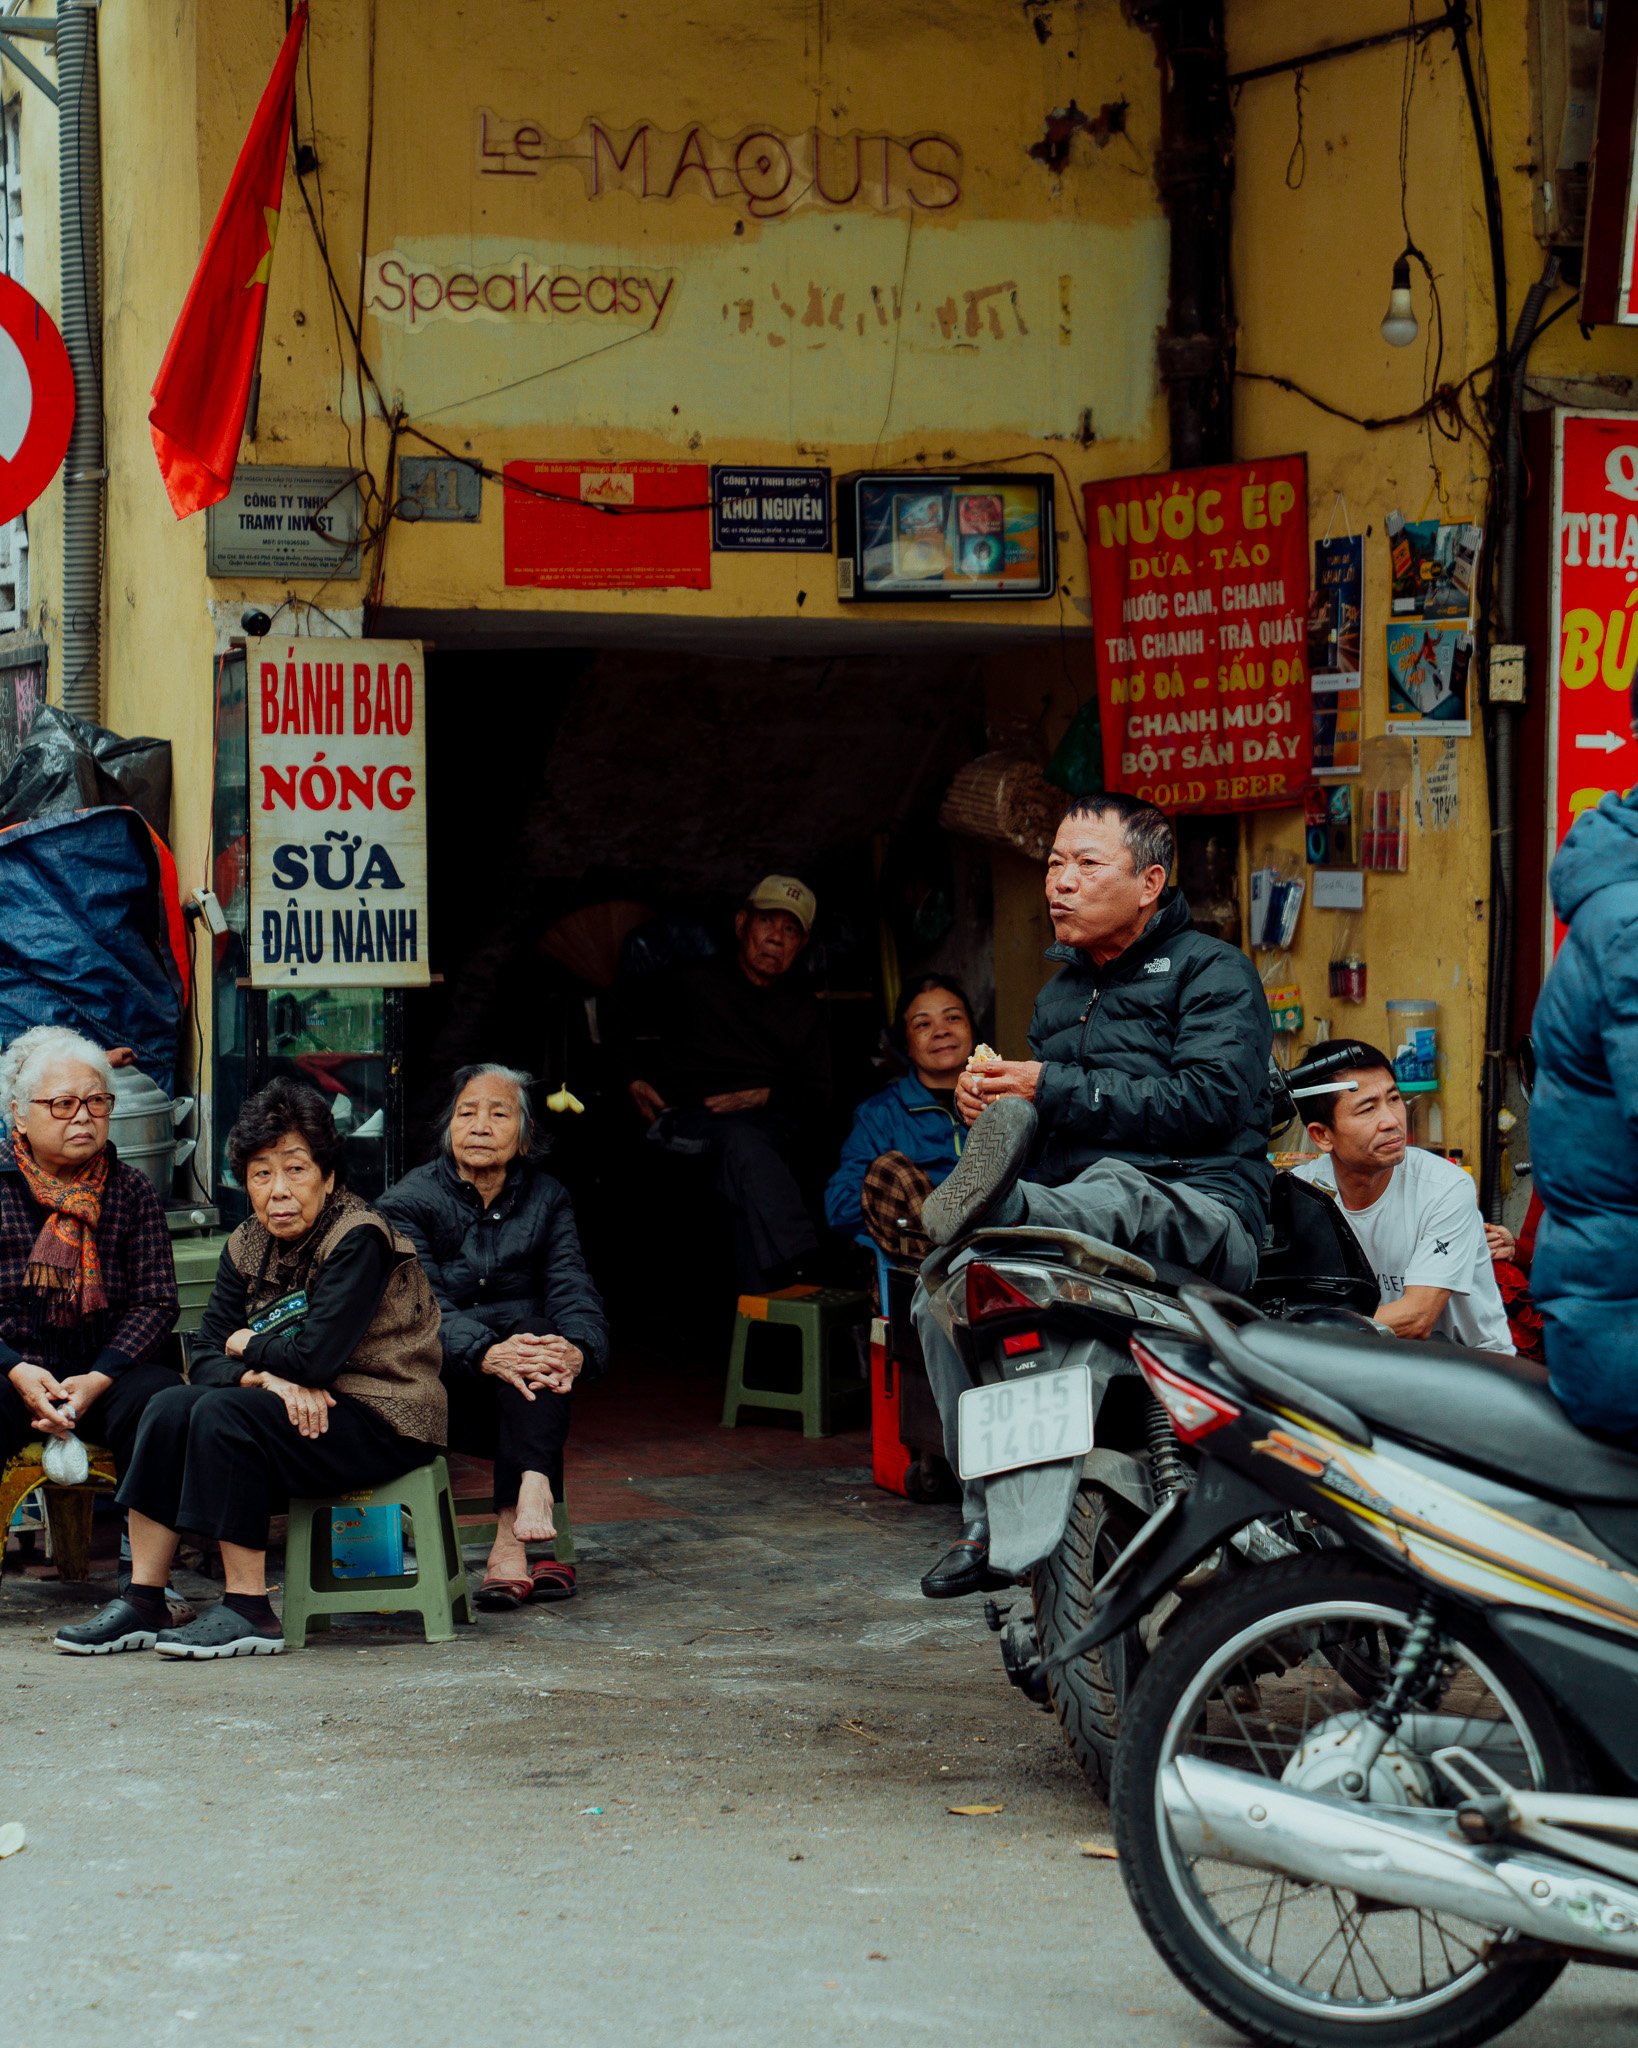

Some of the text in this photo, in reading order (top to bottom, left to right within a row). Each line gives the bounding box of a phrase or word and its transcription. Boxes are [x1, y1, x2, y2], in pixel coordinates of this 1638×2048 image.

[480, 113, 962, 218] Le MAQUIS
[373, 260, 674, 330] Speakeasy
[243, 492, 276, 508] CÔNG
[280, 495, 293, 508] TY
[416, 467, 461, 512] 41
[721, 487, 823, 521] KHỞI NGUYÊN
[722, 475, 747, 486] CÔNG
[749, 477, 760, 486] TY
[761, 477, 784, 487] TNHH
[238, 514, 283, 530] TRAMY
[1097, 471, 1296, 548] NƯỚC ÉP
[1129, 551, 1192, 581] DỨA
[1209, 540, 1270, 570] TÁO
[1122, 579, 1285, 623] NƯỚC CAM, CHANH
[1105, 632, 1137, 664] TRÀ
[1141, 628, 1205, 660] CHANH
[1218, 617, 1254, 651] TRÀ
[1258, 608, 1304, 649] QUẤT
[260, 646, 413, 736] BÁNH BAO
[1152, 662, 1185, 700] ĐÁ
[1217, 651, 1265, 693] SẤU
[1271, 650, 1305, 687] ĐÁ
[1127, 692, 1291, 739] CHANH MUỐI
[1121, 731, 1301, 778] BỘT SẮN DÂY
[259, 751, 416, 811] NÓNG
[1136, 773, 1288, 807] COLD BEER
[271, 830, 406, 890] SỮA
[261, 897, 418, 976] ĐẬU NÀNH
[978, 1374, 1070, 1427] 30-L5
[981, 1414, 1070, 1466] 1407
